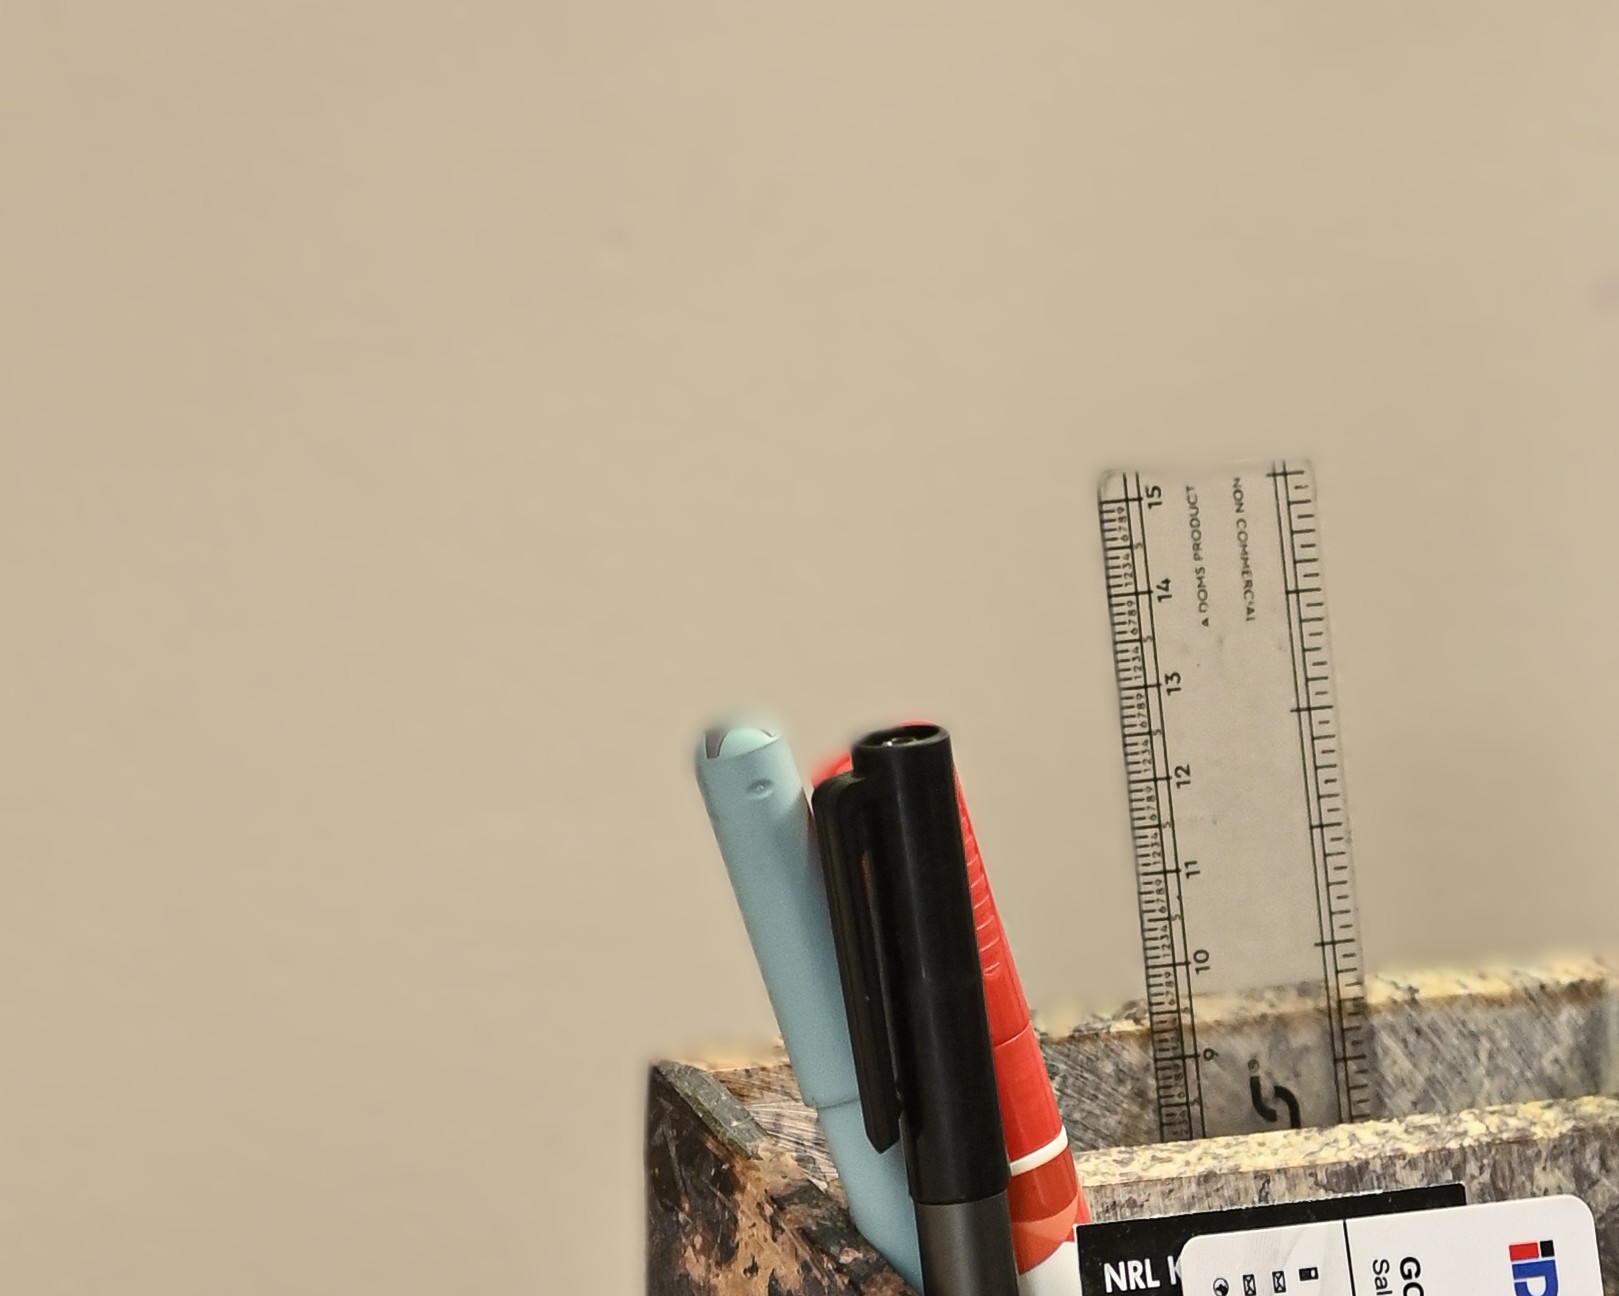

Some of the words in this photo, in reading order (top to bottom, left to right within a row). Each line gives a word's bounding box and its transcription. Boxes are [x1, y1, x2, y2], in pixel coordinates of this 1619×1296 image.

[1145, 485, 1163, 510] 15
[1233, 476, 1245, 514] NON
[1185, 485, 1203, 562] PRODUCT
[1156, 578, 1173, 603] 14
[1164, 671, 1182, 696] 13
[1174, 763, 1191, 789] 12
[1184, 860, 1200, 879] 11
[1193, 949, 1210, 976] 10
[1203, 1047, 1219, 1062] 9
[1103, 1258, 1160, 1293] NRL
